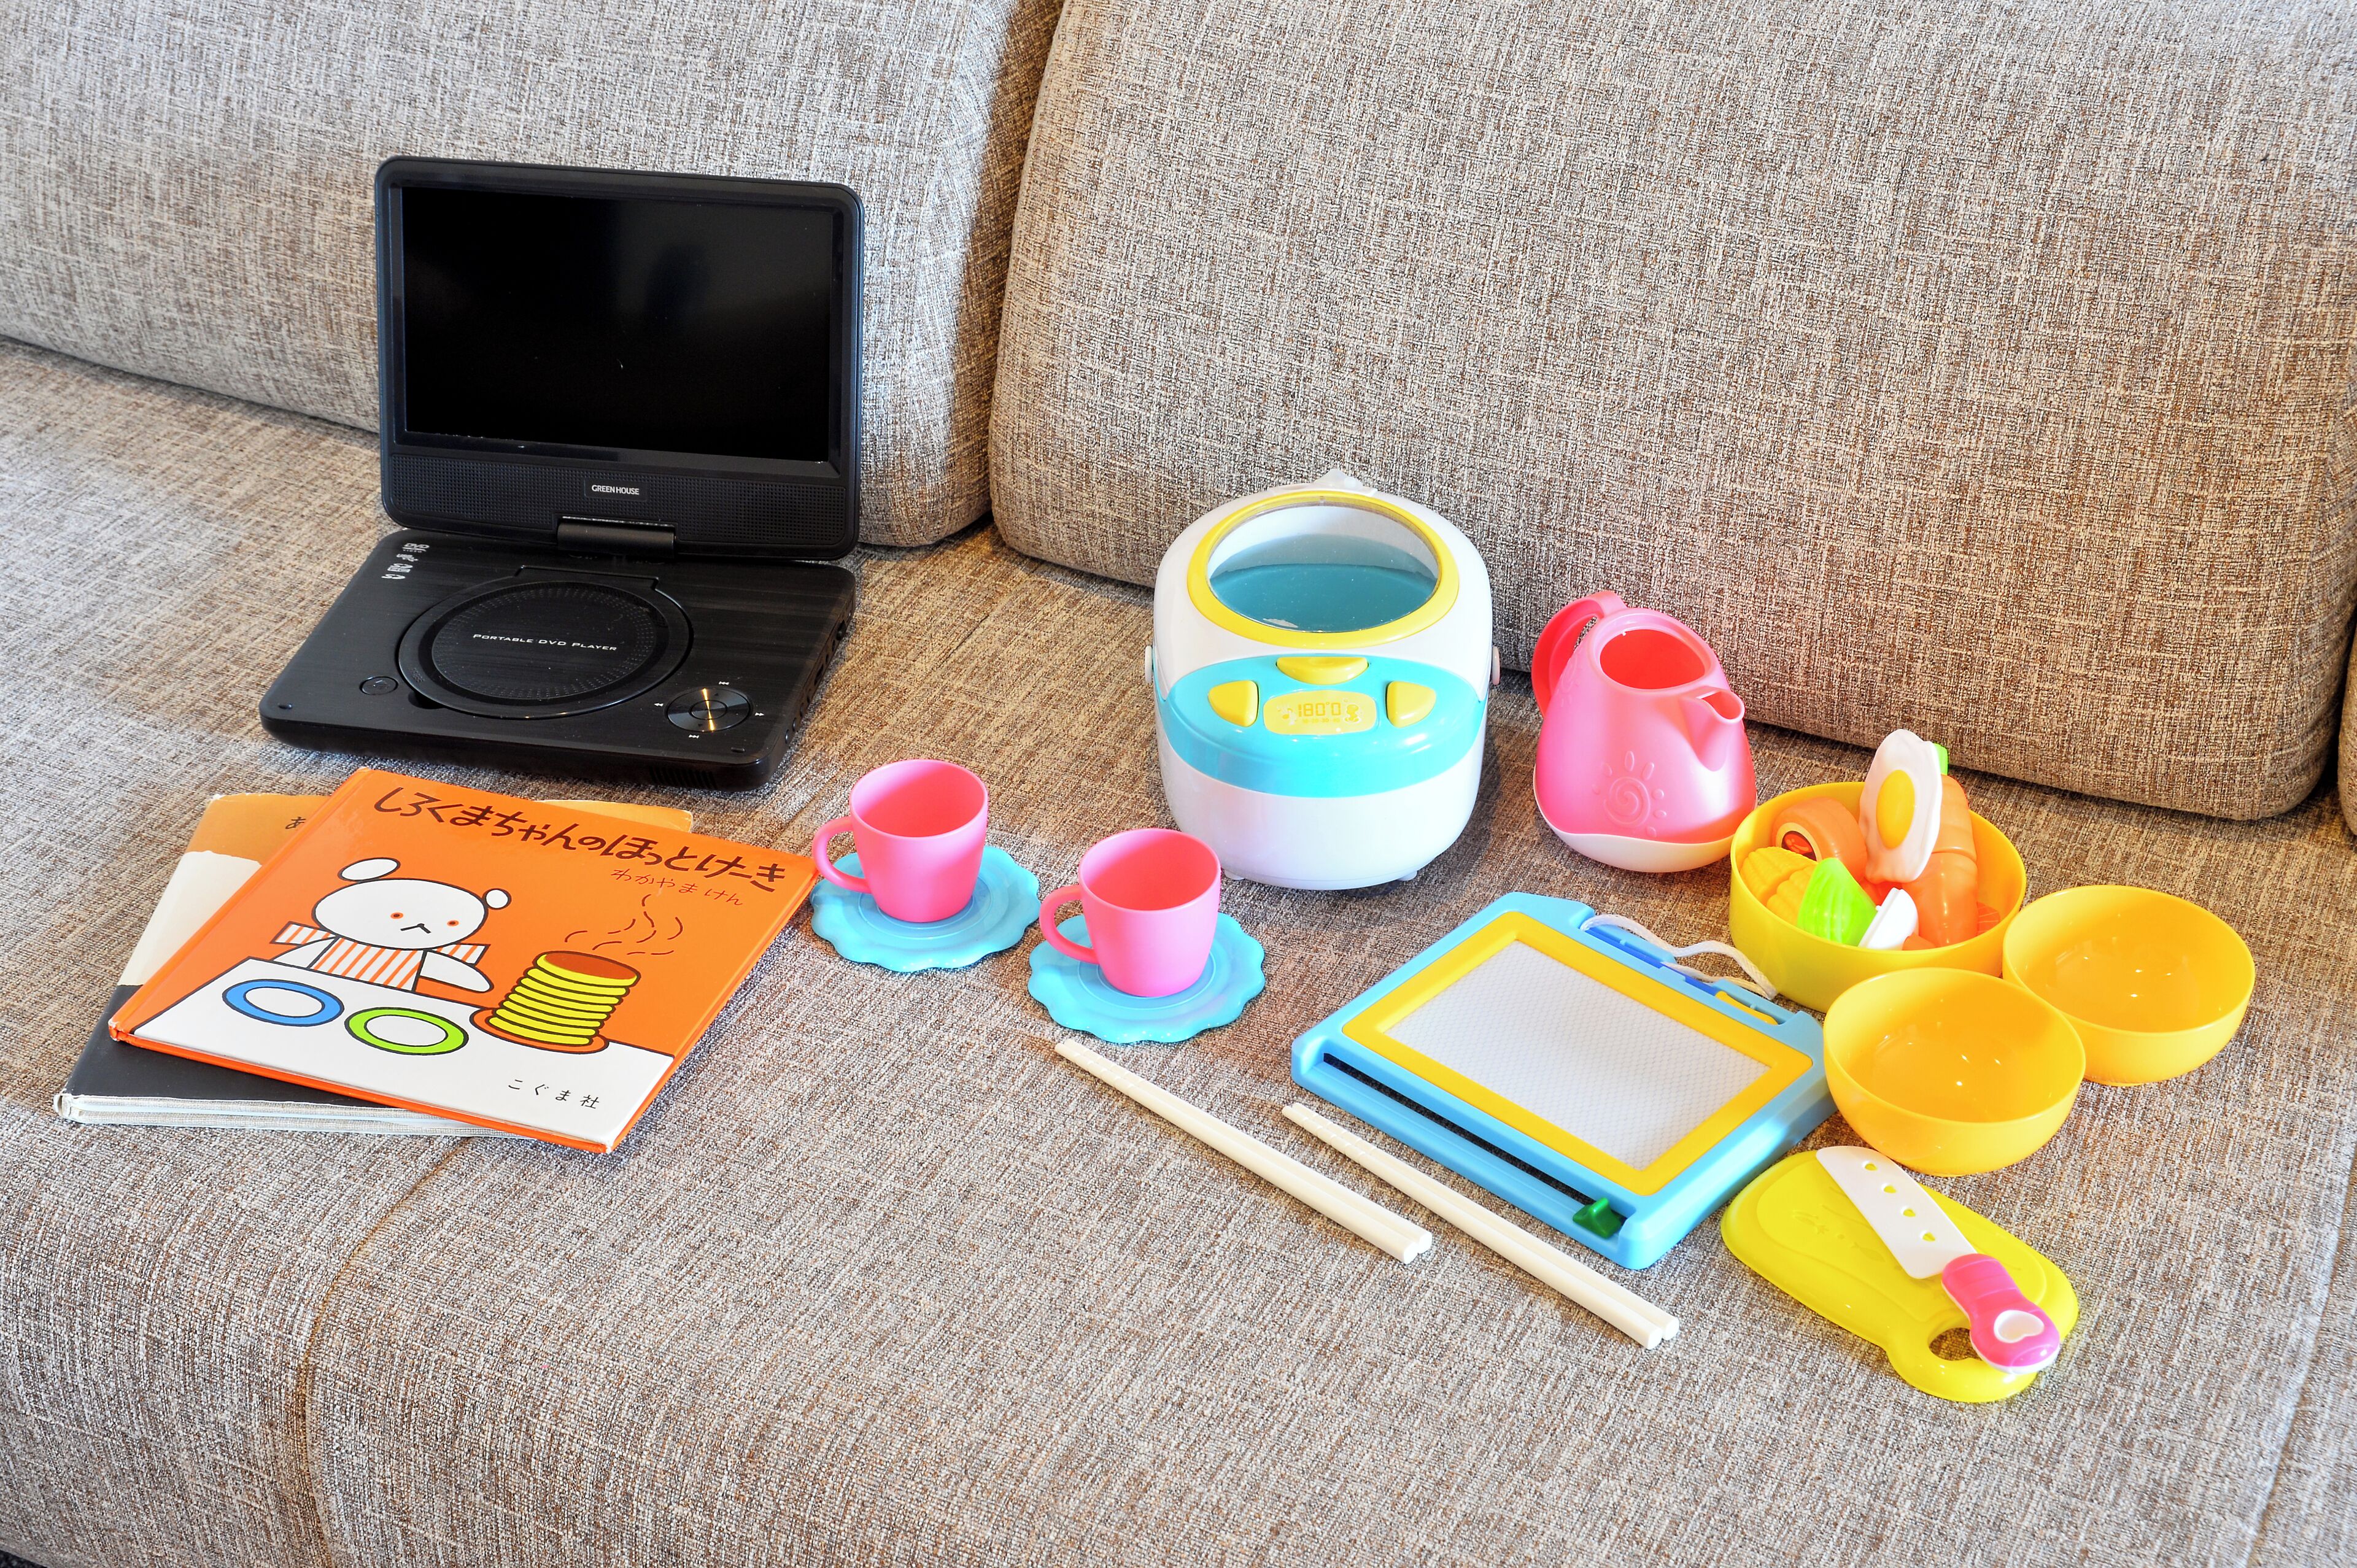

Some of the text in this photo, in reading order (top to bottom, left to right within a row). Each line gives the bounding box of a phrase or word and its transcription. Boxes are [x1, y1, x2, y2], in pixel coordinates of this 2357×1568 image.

[591, 484, 640, 495] GREEN HOUSE
[374, 786, 786, 893] しろくまちゃんのほっとけーき
[610, 868, 743, 906] わかやま けん
[508, 1078, 600, 1110] こぐま社
